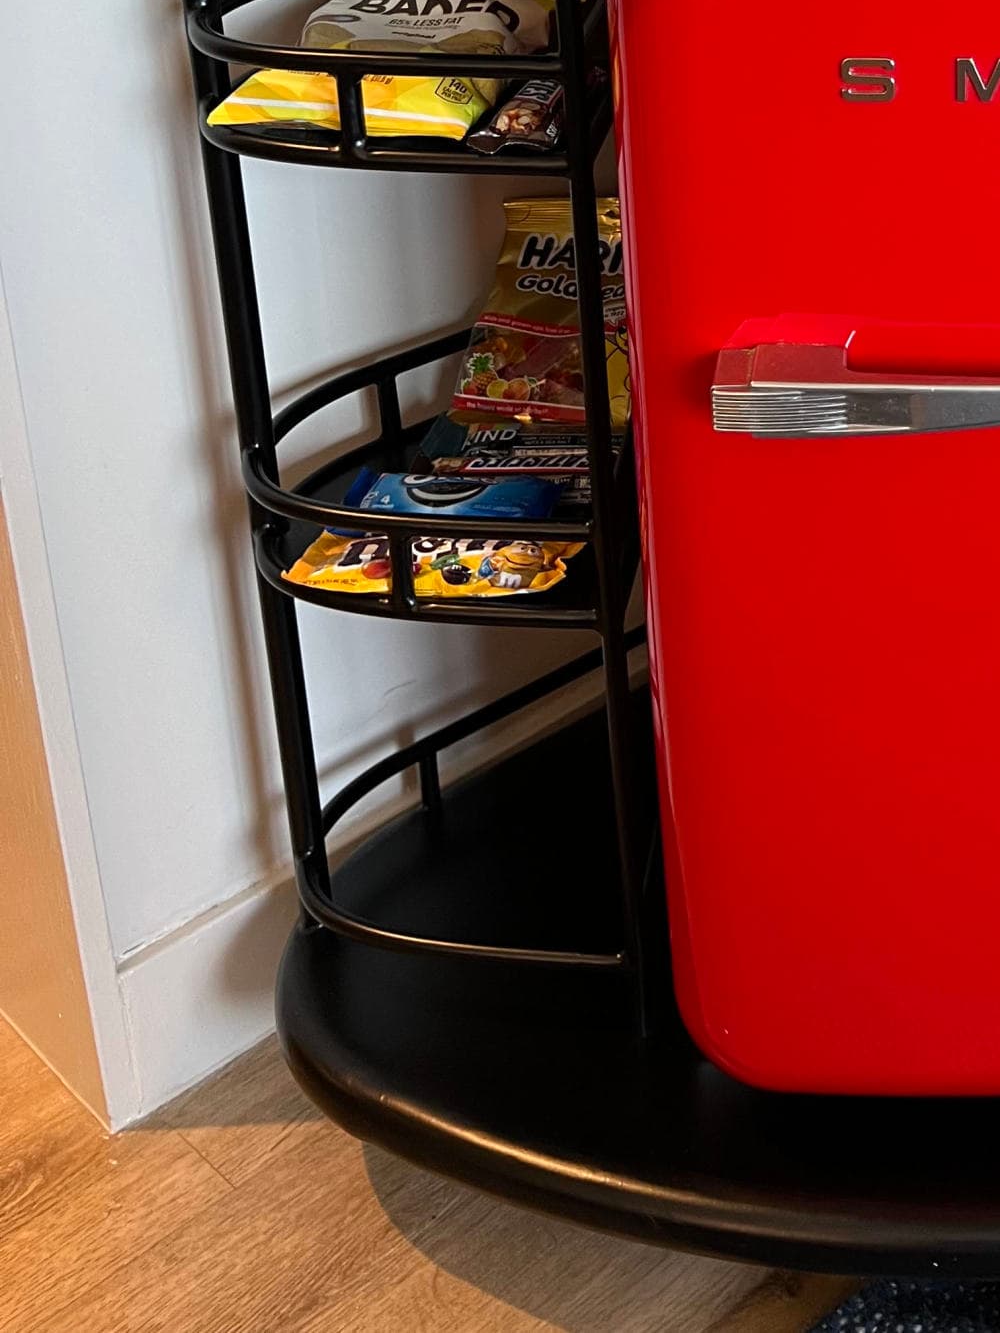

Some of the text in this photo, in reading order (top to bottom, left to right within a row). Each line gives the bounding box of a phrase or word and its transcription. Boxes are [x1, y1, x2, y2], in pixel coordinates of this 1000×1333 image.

[413, 17, 443, 27] LESS
[443, 16, 465, 25] FAT
[380, 495, 390, 505] 4
